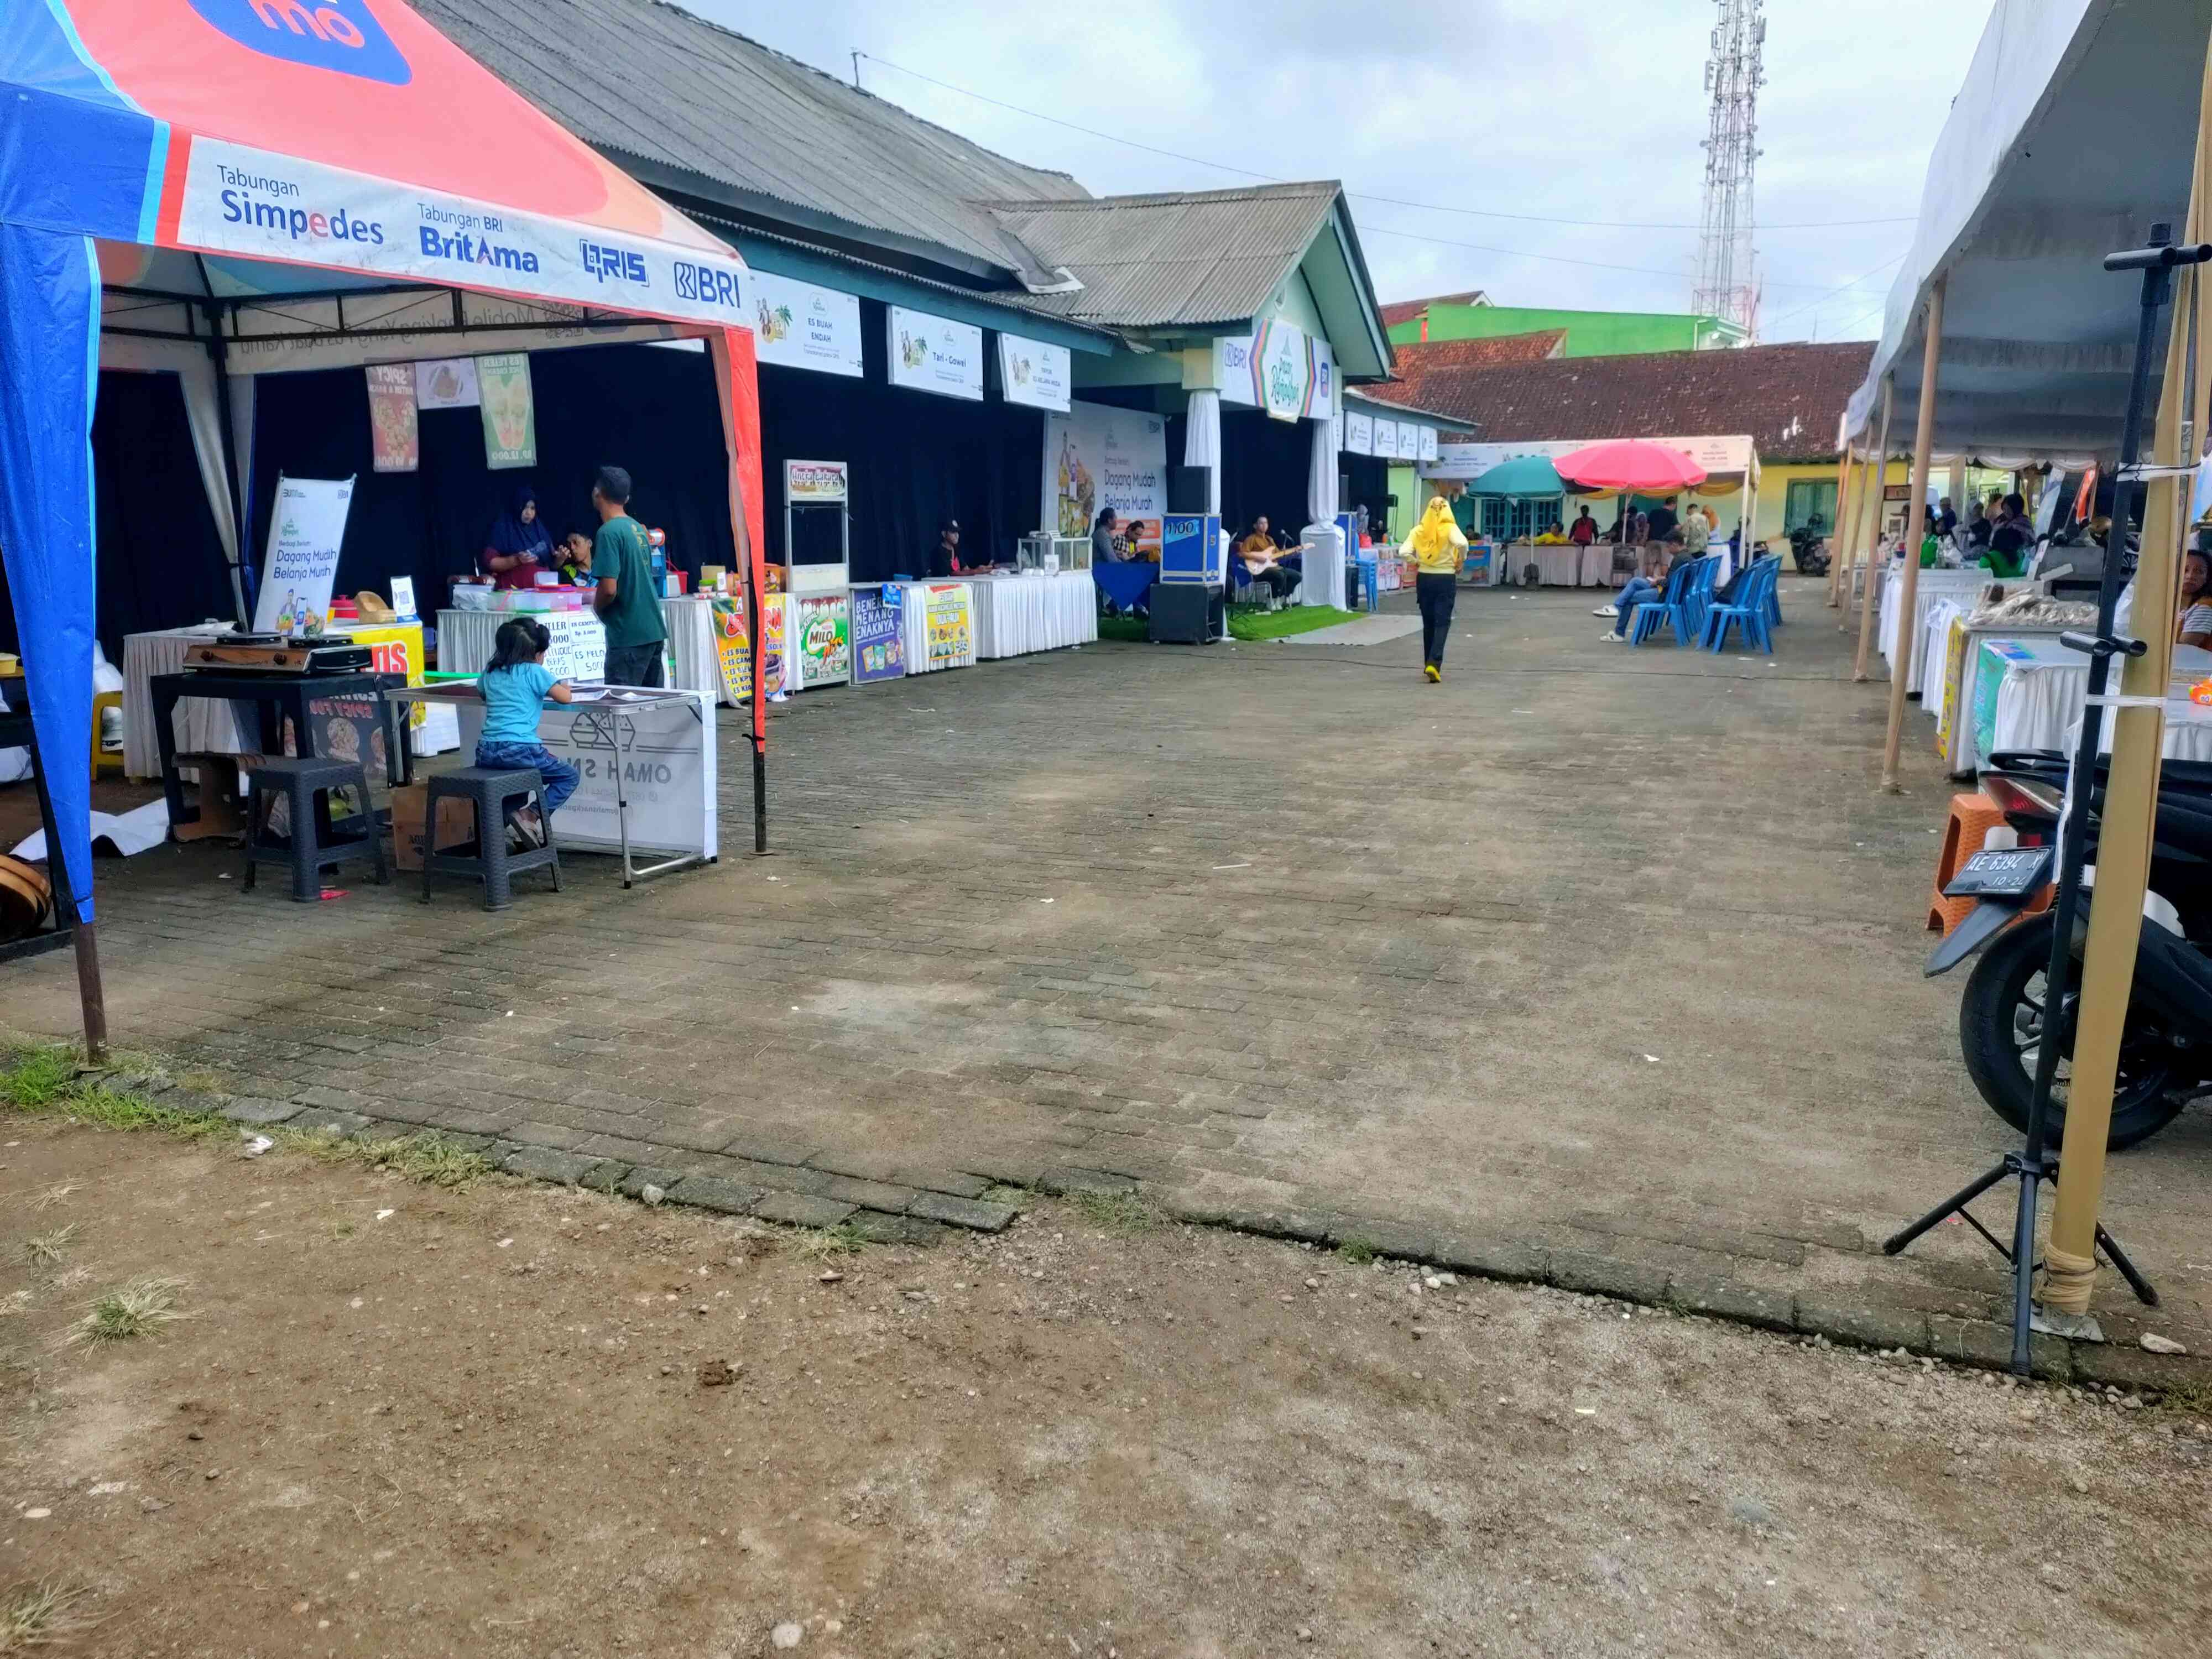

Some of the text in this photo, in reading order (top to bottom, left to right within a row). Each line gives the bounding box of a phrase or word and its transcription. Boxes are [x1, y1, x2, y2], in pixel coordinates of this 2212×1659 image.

[216, 164, 300, 197] Tabungan
[221, 190, 384, 245] Simpedes
[417, 203, 503, 232] Tabungan BRI
[419, 226, 539, 274] BritAma
[582, 242, 647, 284] QRIS
[698, 267, 740, 309] BRI
[1234, 347, 1247, 368] BRI
[1105, 469, 1156, 491] Dagang Mudah
[1132, 495, 1153, 510] Murah
[276, 550, 311, 565] Dagang
[274, 566, 307, 582] Belanja
[855, 608, 895, 627] MENANG
[809, 630, 833, 645] MILO
[855, 618, 895, 640] ENAKNYA
[1966, 856, 1991, 872] AE
